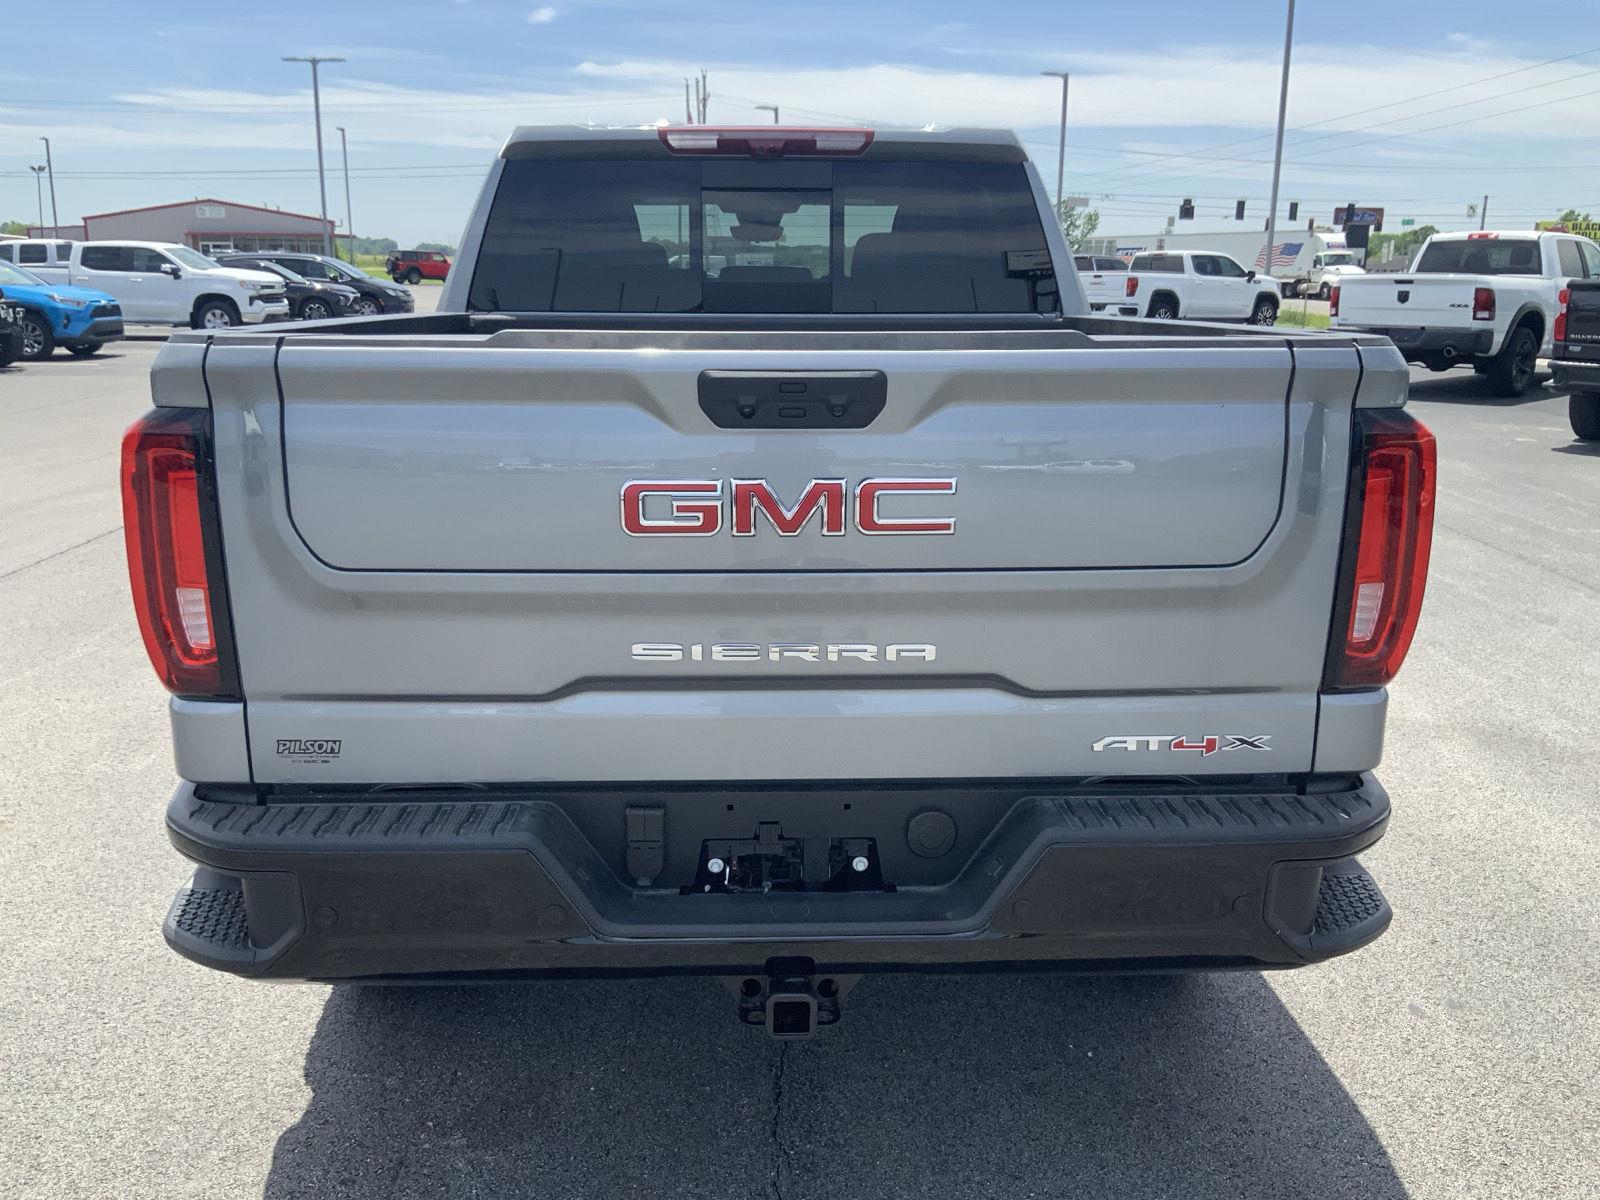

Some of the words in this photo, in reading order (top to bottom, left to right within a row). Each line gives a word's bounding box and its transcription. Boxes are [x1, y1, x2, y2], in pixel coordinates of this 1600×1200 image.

[620, 478, 957, 537] GMC
[631, 643, 937, 661] SIERRA
[276, 739, 341, 754] PILSON
[1092, 735, 1272, 757] AT4X
